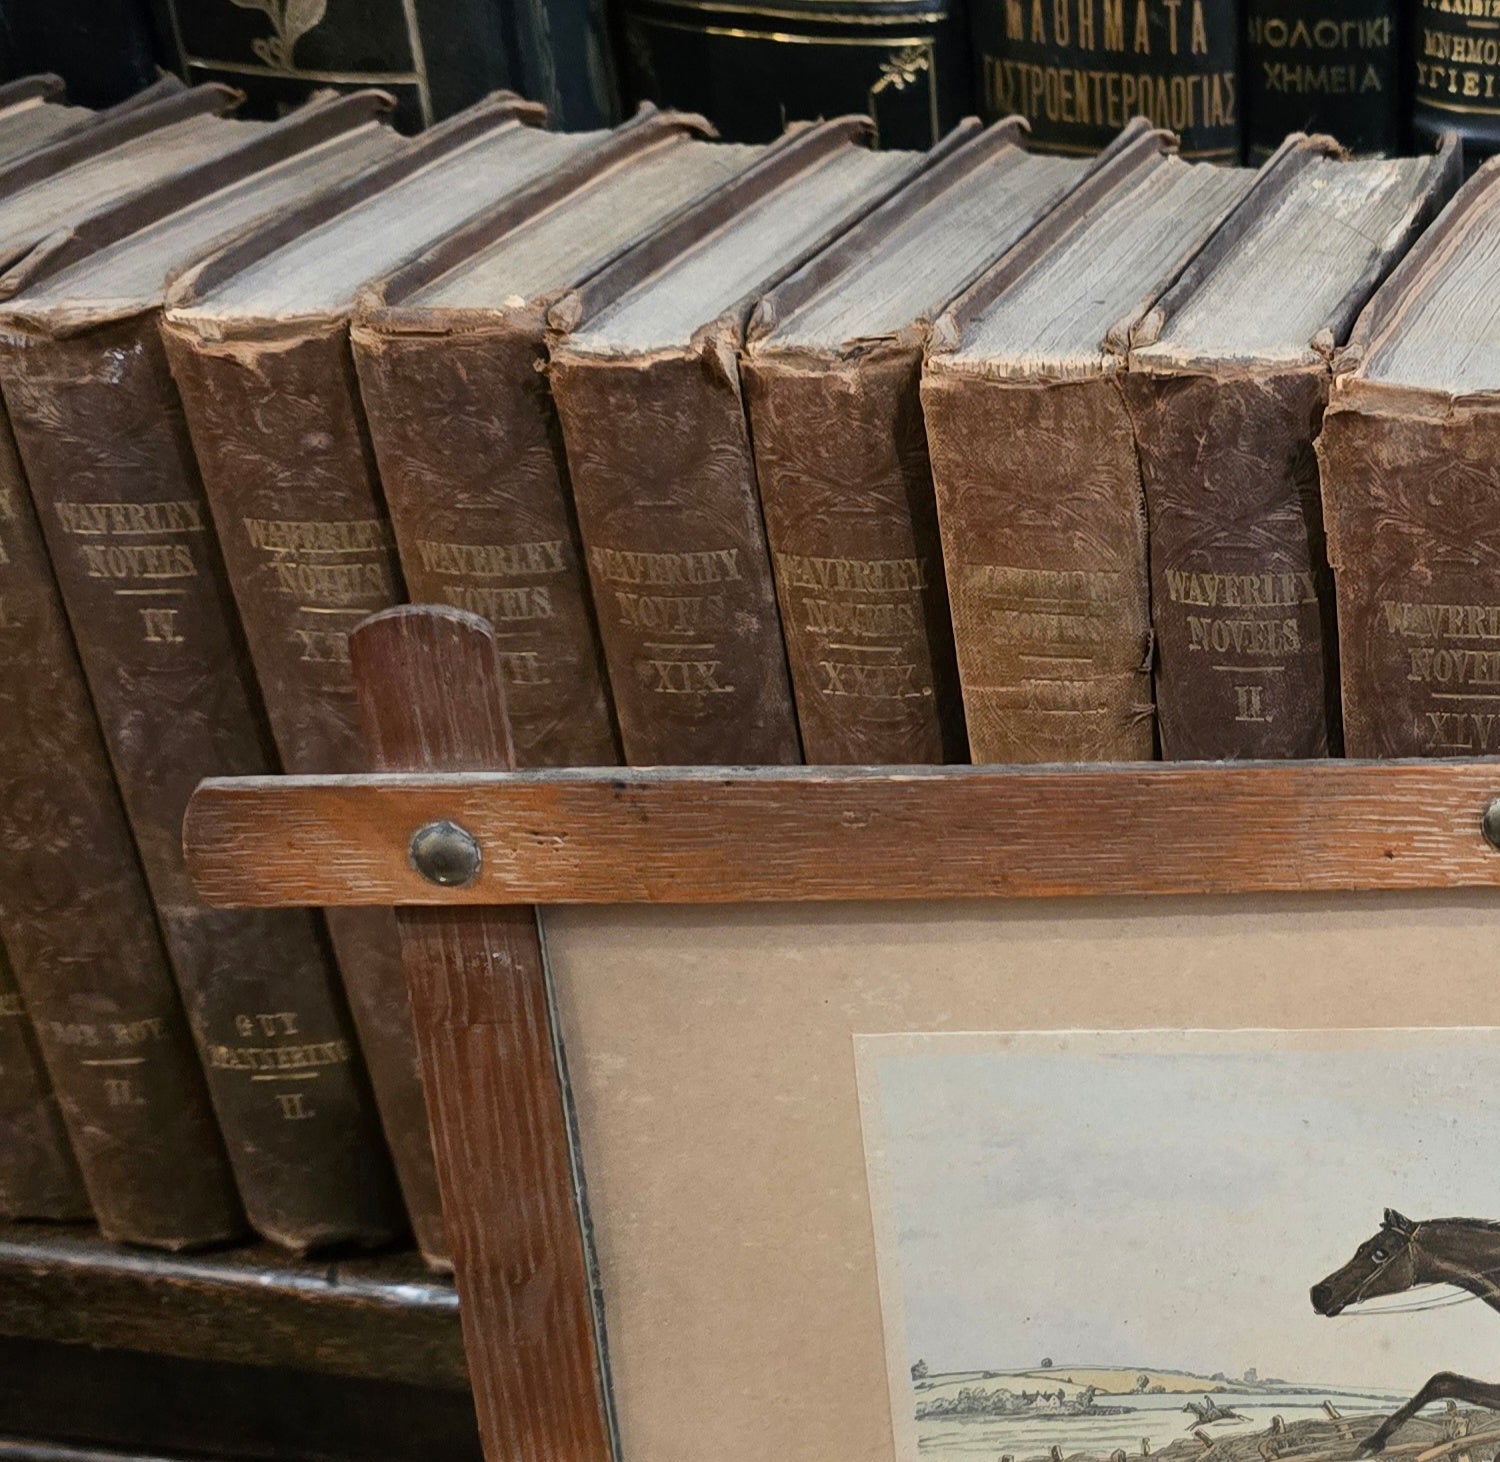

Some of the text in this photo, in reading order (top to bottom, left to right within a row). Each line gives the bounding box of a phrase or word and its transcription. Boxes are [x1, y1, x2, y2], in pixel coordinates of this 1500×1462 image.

[1263, 61, 1383, 95] ΧΗΜΕΙΑ
[1164, 568, 1320, 607] WAVERLEY
[1187, 615, 1302, 655] NOVELS
